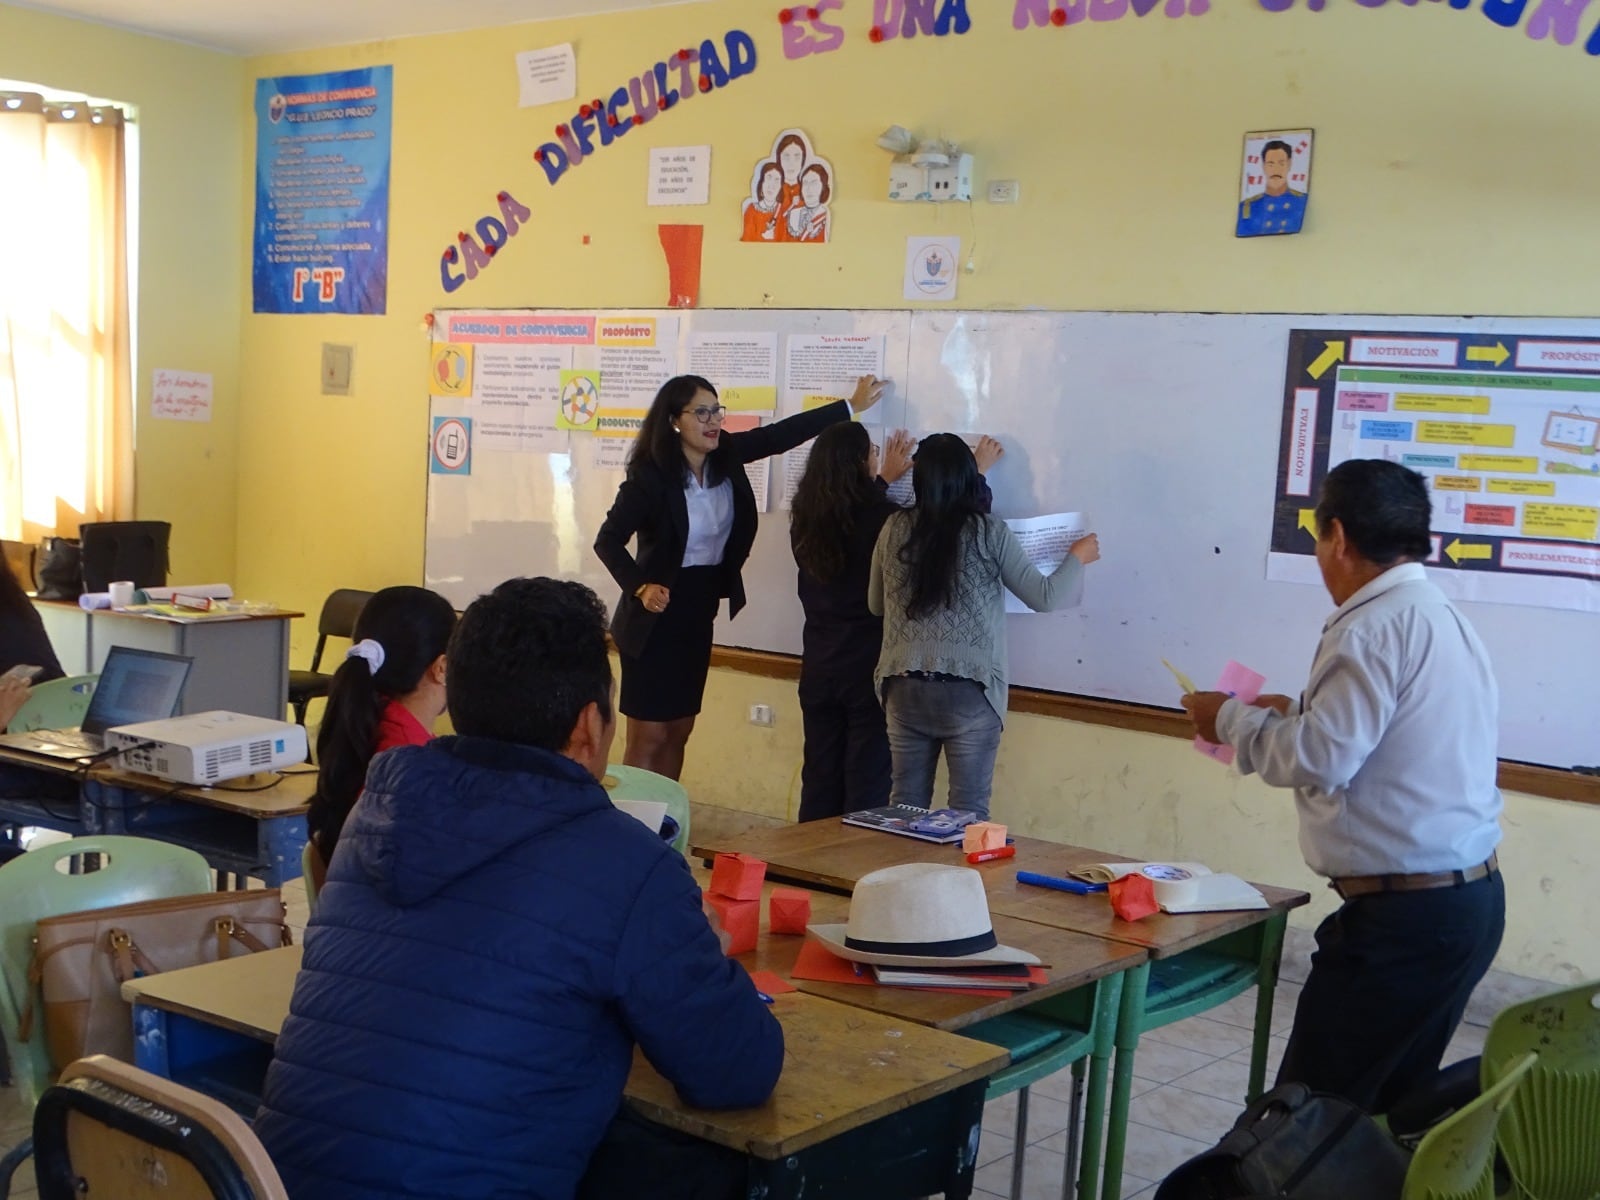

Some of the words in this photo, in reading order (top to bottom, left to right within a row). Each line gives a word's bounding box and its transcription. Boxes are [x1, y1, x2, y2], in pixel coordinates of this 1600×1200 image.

[440, 190, 532, 294] CADA
[533, 29, 757, 186] DIFICULTAD
[779, 0, 844, 60] ES
[870, 0, 971, 42] UNA
[453, 323, 500, 335] ACUERDOS
[506, 324, 518, 336] DE
[521, 324, 589, 336] CONVIVENCIA
[602, 325, 651, 337] PROPÓSITO
[1367, 345, 1440, 358] MOTIVACIÓN
[1295, 408, 1309, 477] EVALUACIÓN
